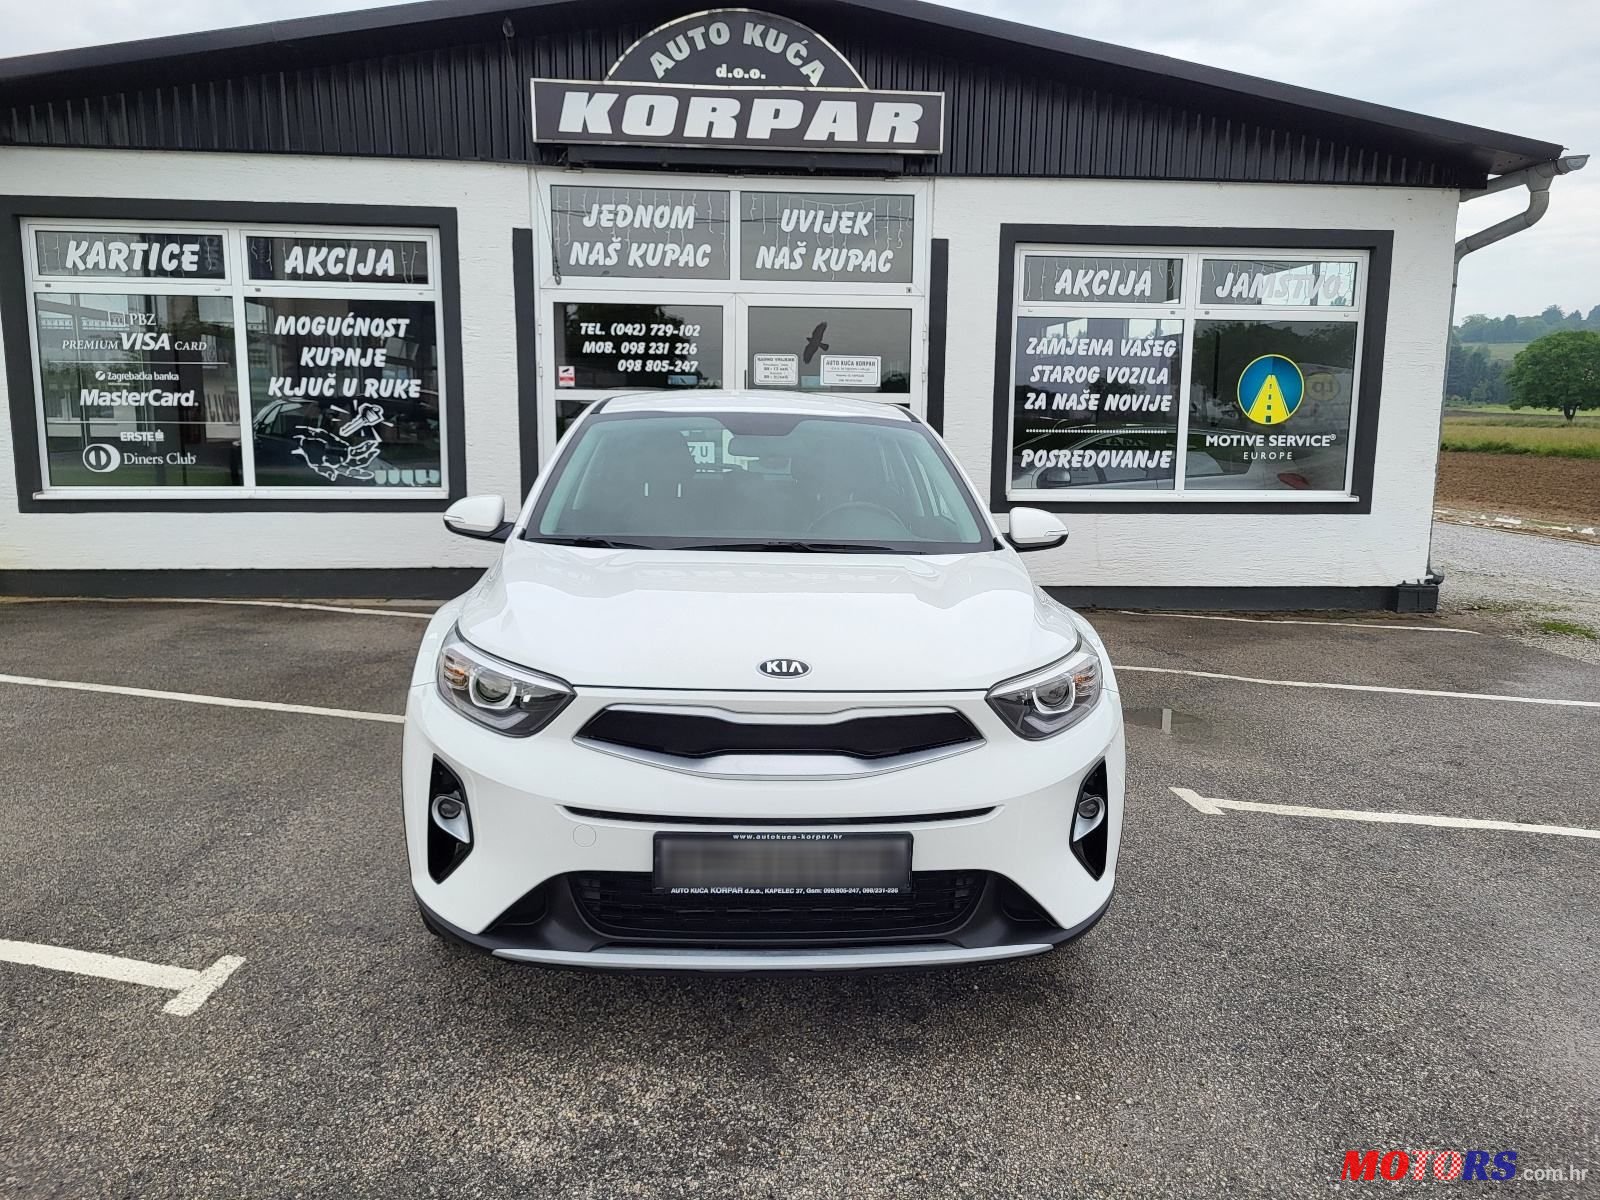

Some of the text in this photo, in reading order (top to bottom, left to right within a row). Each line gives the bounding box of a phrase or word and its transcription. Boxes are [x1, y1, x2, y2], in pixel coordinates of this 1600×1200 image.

[650, 22, 826, 86] AUTO KUĆA
[716, 64, 766, 79] d.o.o.
[558, 91, 923, 143] KORPAR
[582, 203, 696, 229] JEDNOM
[780, 209, 873, 236] UVIJEK
[65, 240, 200, 272] KARTICE
[284, 246, 395, 276] AKCIJA
[569, 238, 711, 268] NAŠ KUPAC
[755, 241, 894, 272] NAŠ KUPAC
[1055, 269, 1151, 297] AKCIJA
[1215, 272, 1343, 299] JAMSTVO
[129, 313, 157, 326] PBZ
[274, 312, 410, 338] MOGUĆNOST
[580, 323, 700, 337] TEL. (042) 729-102
[62, 332, 207, 350] PREMIUM VISA CARD
[582, 341, 697, 355] MOB. 098 231 226
[1026, 336, 1177, 357] ZAMJENA VAŠEG
[300, 347, 387, 368] KUPNJE
[617, 360, 698, 373] 098 805-247
[154, 371, 179, 381] banka
[1030, 365, 1169, 385] STAROG VOZILA
[268, 373, 422, 399] KLJUČ U RUKE
[1024, 389, 1173, 412] ZA NAŠE NOVIJE
[120, 432, 154, 442] ERSTE
[1205, 434, 1265, 447] MOTIVE
[123, 453, 164, 465] Diners
[1021, 449, 1172, 469] POSREDOVANJE
[1243, 452, 1293, 460] EUROPE
[766, 661, 803, 673] KIA
